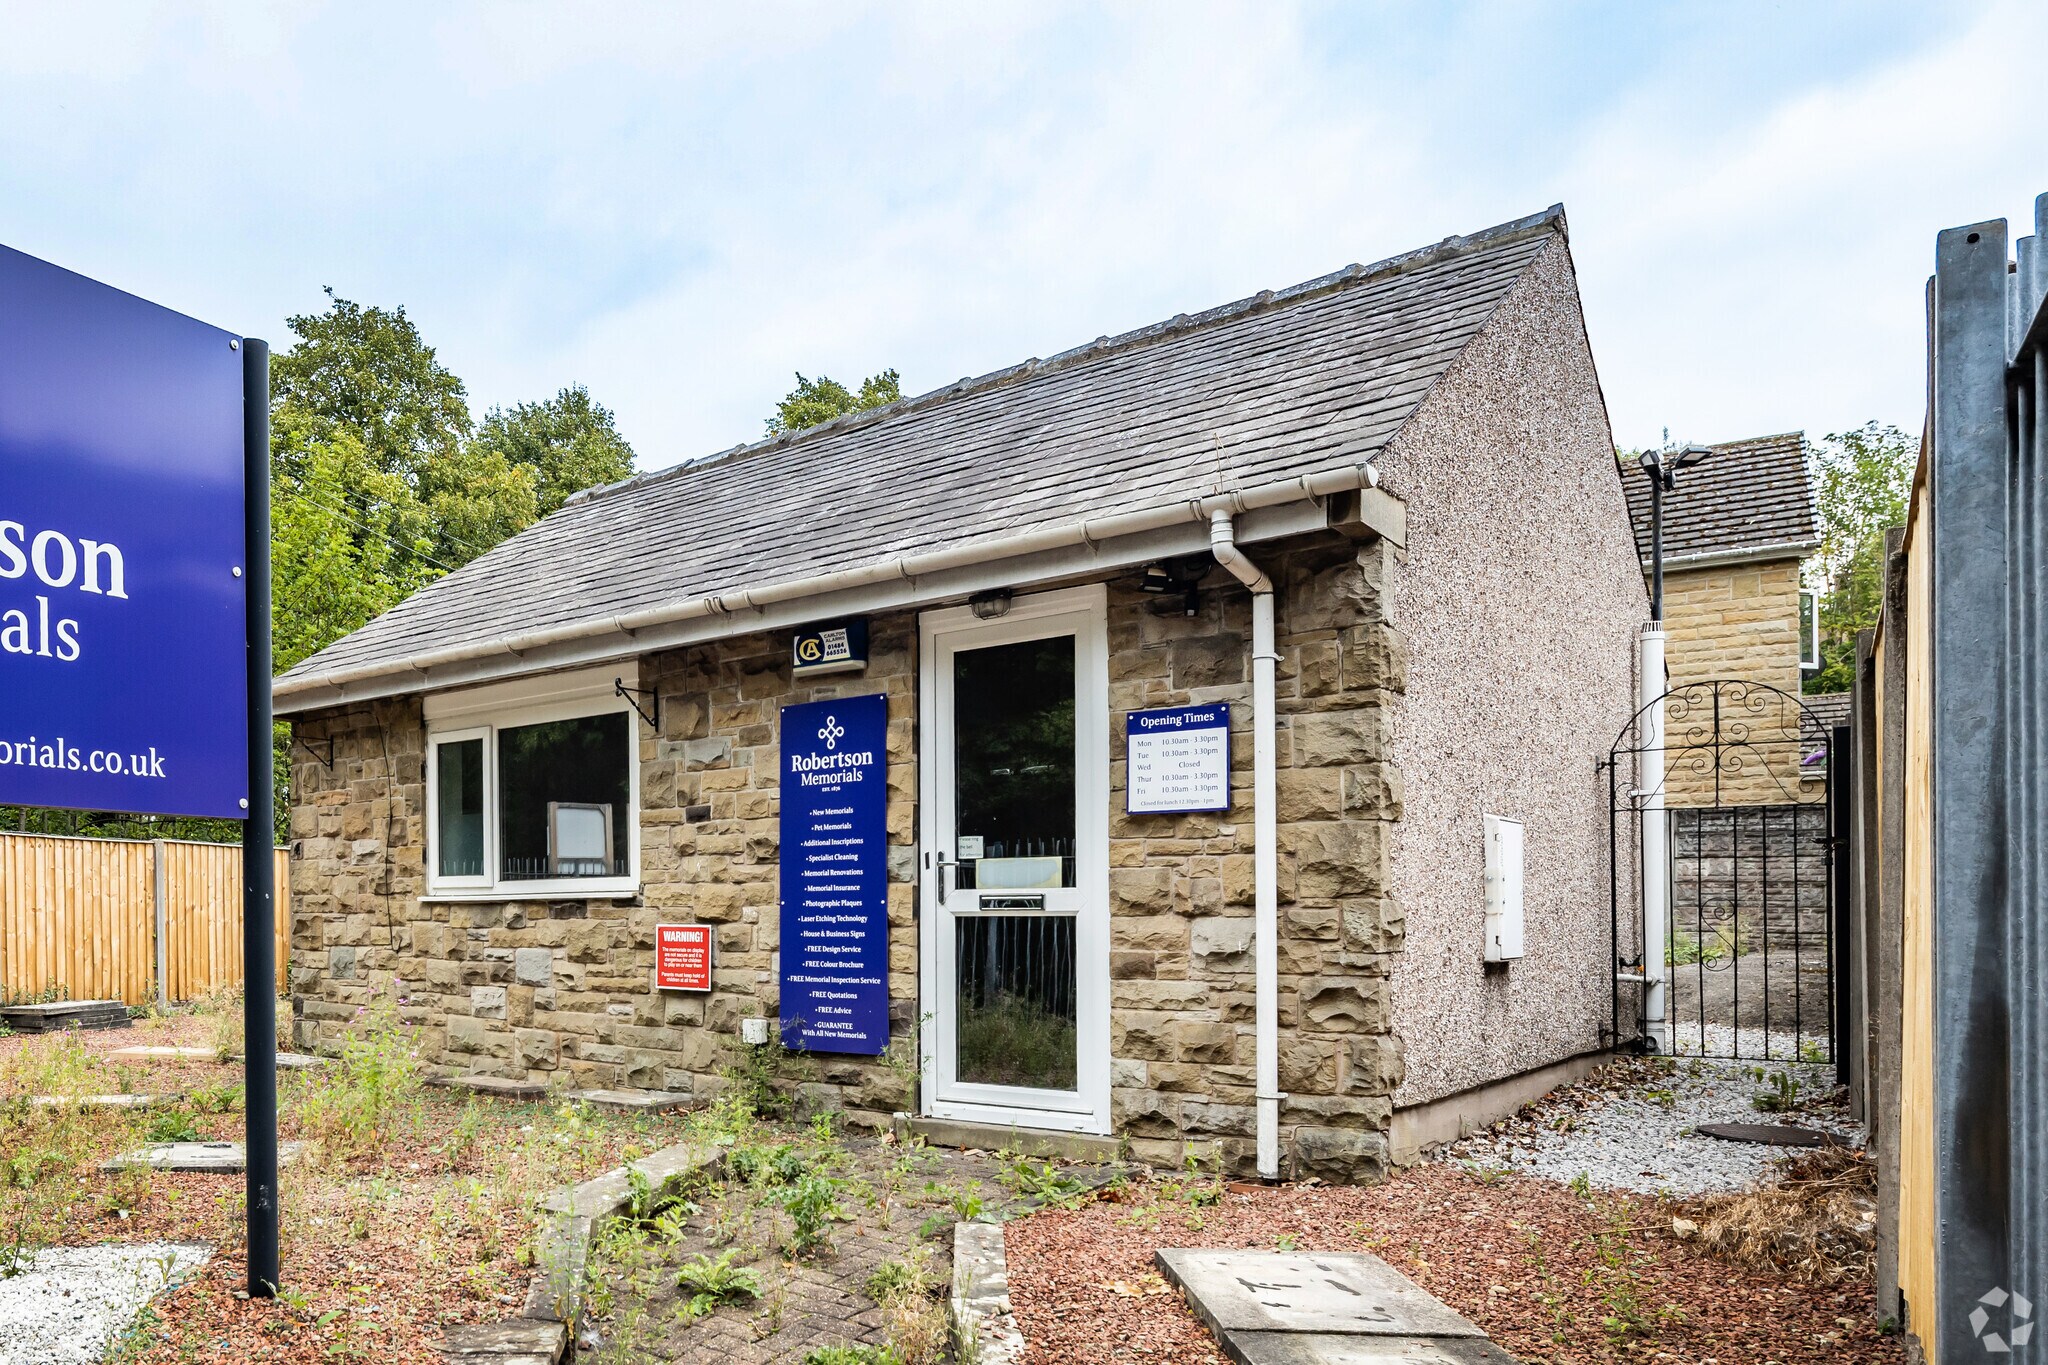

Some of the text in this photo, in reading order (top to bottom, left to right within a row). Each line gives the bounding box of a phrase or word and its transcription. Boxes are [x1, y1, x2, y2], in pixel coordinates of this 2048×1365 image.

[1141, 713, 1214, 729] Opening Times
[1194, 735, 1218, 743] 3.30pm
[792, 752, 873, 772] Robertson
[801, 768, 863, 786] Memorials
[1194, 772, 1218, 780] 3.30pm
[832, 838, 863, 846] Inscriptions
[809, 853, 858, 863] Specialist Cleaning
[664, 931, 703, 942] WARNING!
[850, 931, 865, 939] Signs
[822, 946, 840, 954] Design
